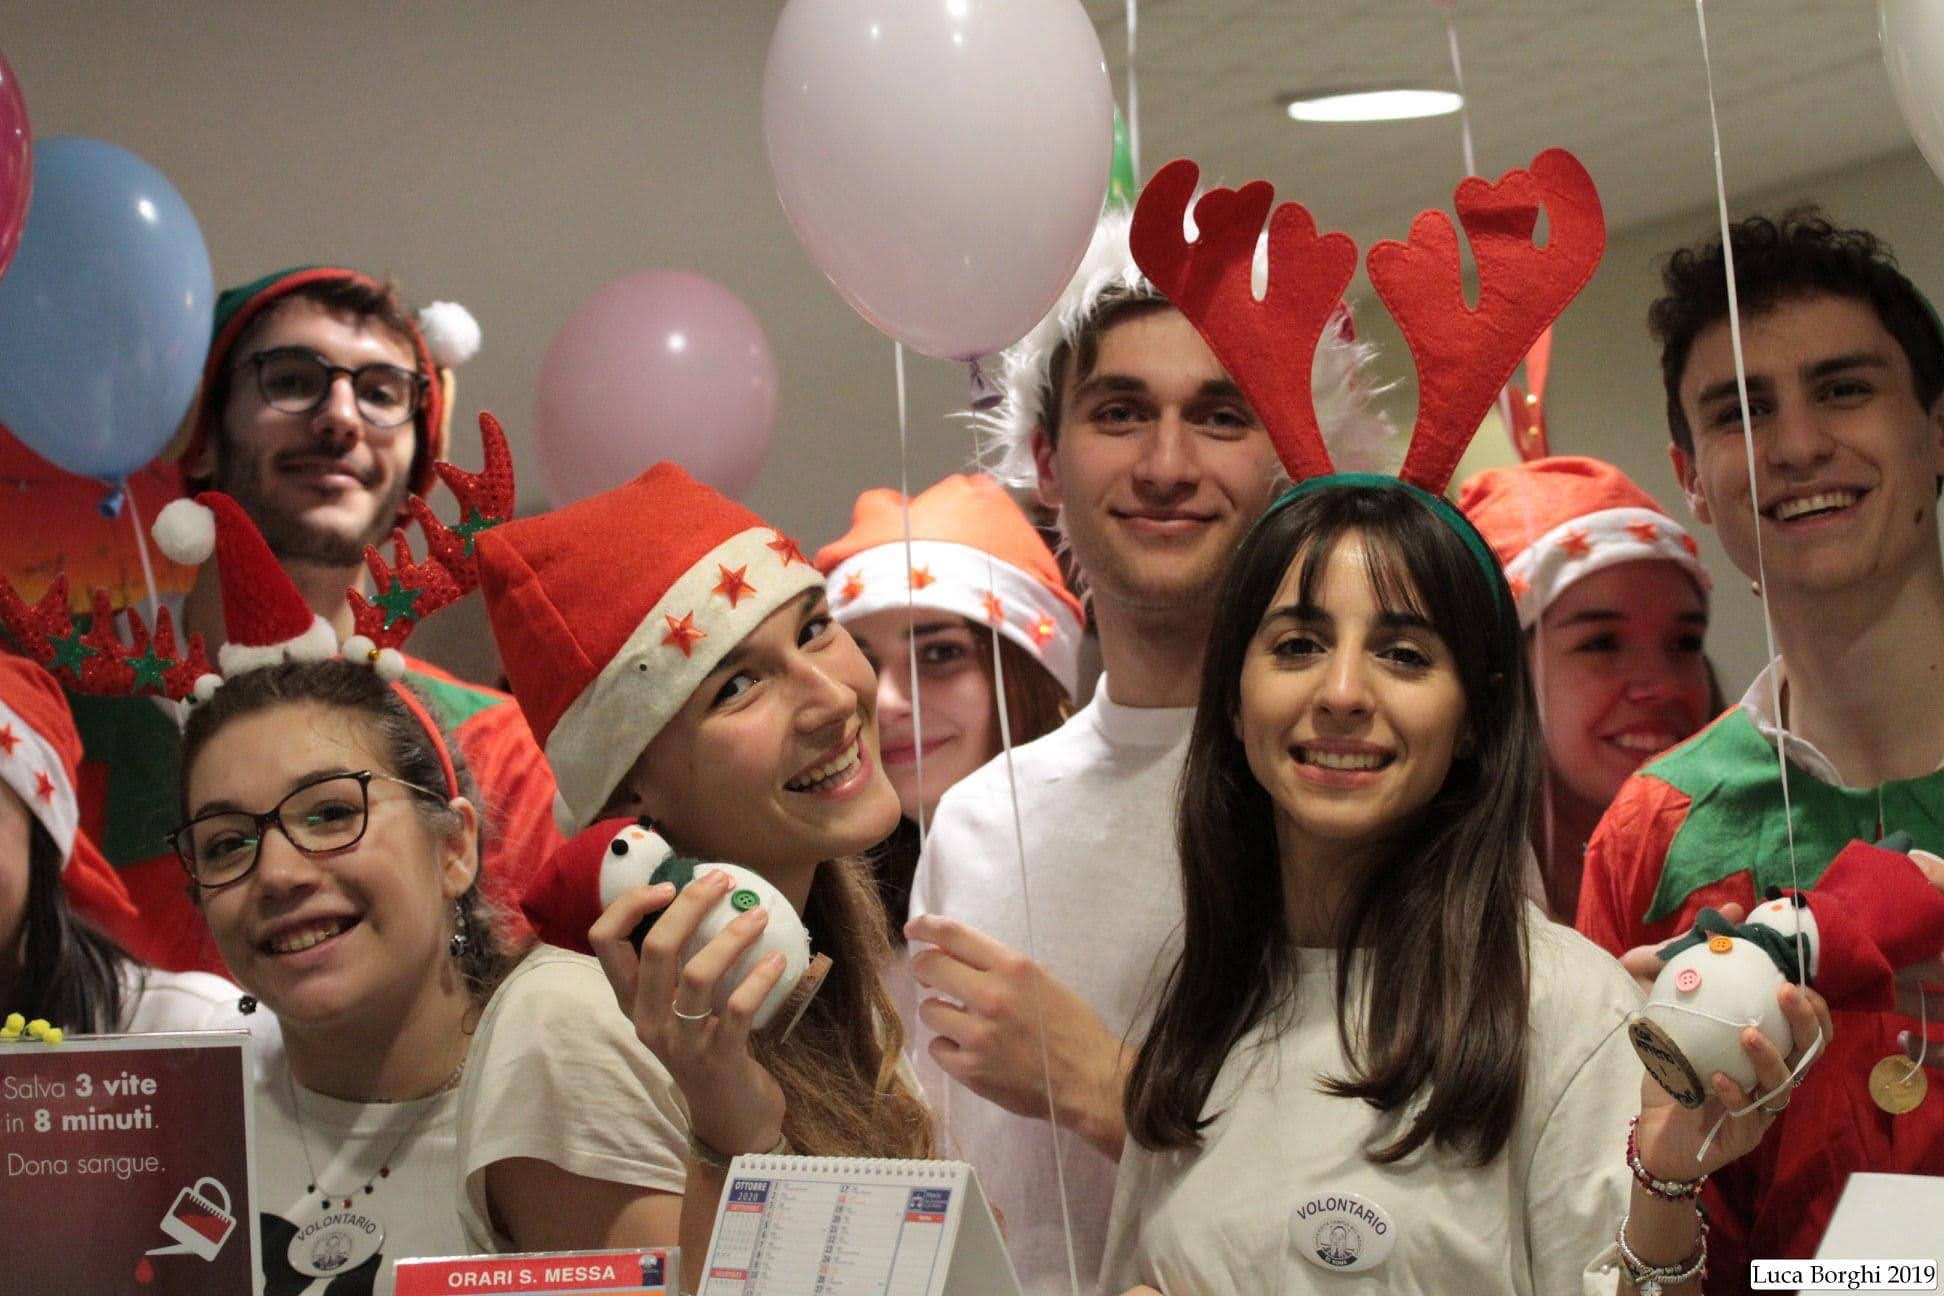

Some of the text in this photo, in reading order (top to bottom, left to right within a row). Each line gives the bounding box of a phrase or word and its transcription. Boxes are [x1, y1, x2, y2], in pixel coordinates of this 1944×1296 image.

[4, 1071, 158, 1099] Salva 3 vite
[6, 1105, 160, 1133] in 8 minuti.
[7, 1153, 167, 1180] Dona sangue.
[297, 1213, 377, 1242] VOLONTARIO
[1297, 1197, 1388, 1236] VOLONTARIO
[447, 1265, 617, 1288] ORARI S. MESSA
